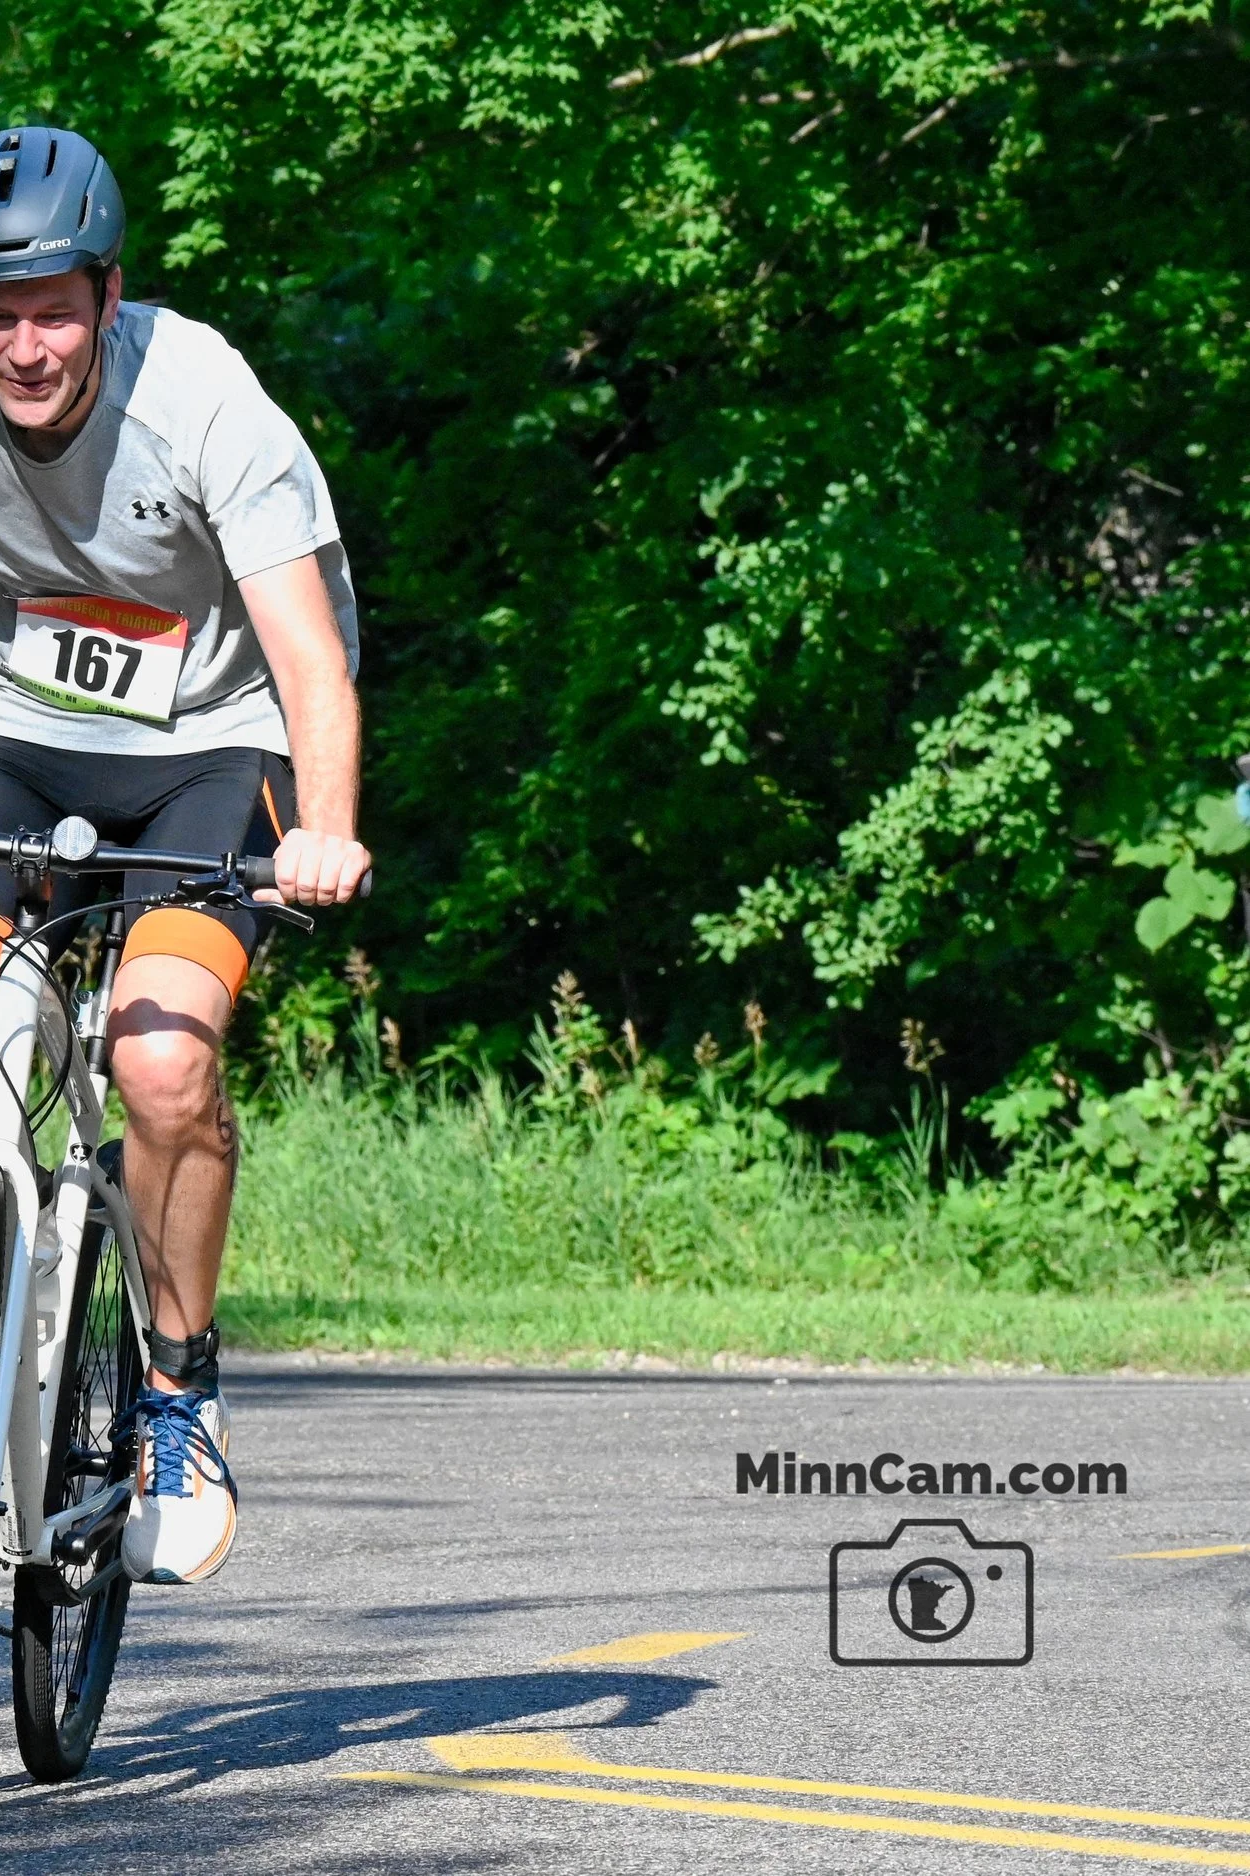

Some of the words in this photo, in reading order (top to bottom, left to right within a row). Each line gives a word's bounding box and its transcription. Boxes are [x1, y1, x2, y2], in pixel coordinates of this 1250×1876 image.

[40, 238, 71, 250] GIRO
[115, 611, 181, 636] TRIATHLON
[53, 628, 143, 700] 167
[66, 694, 78, 704] MN
